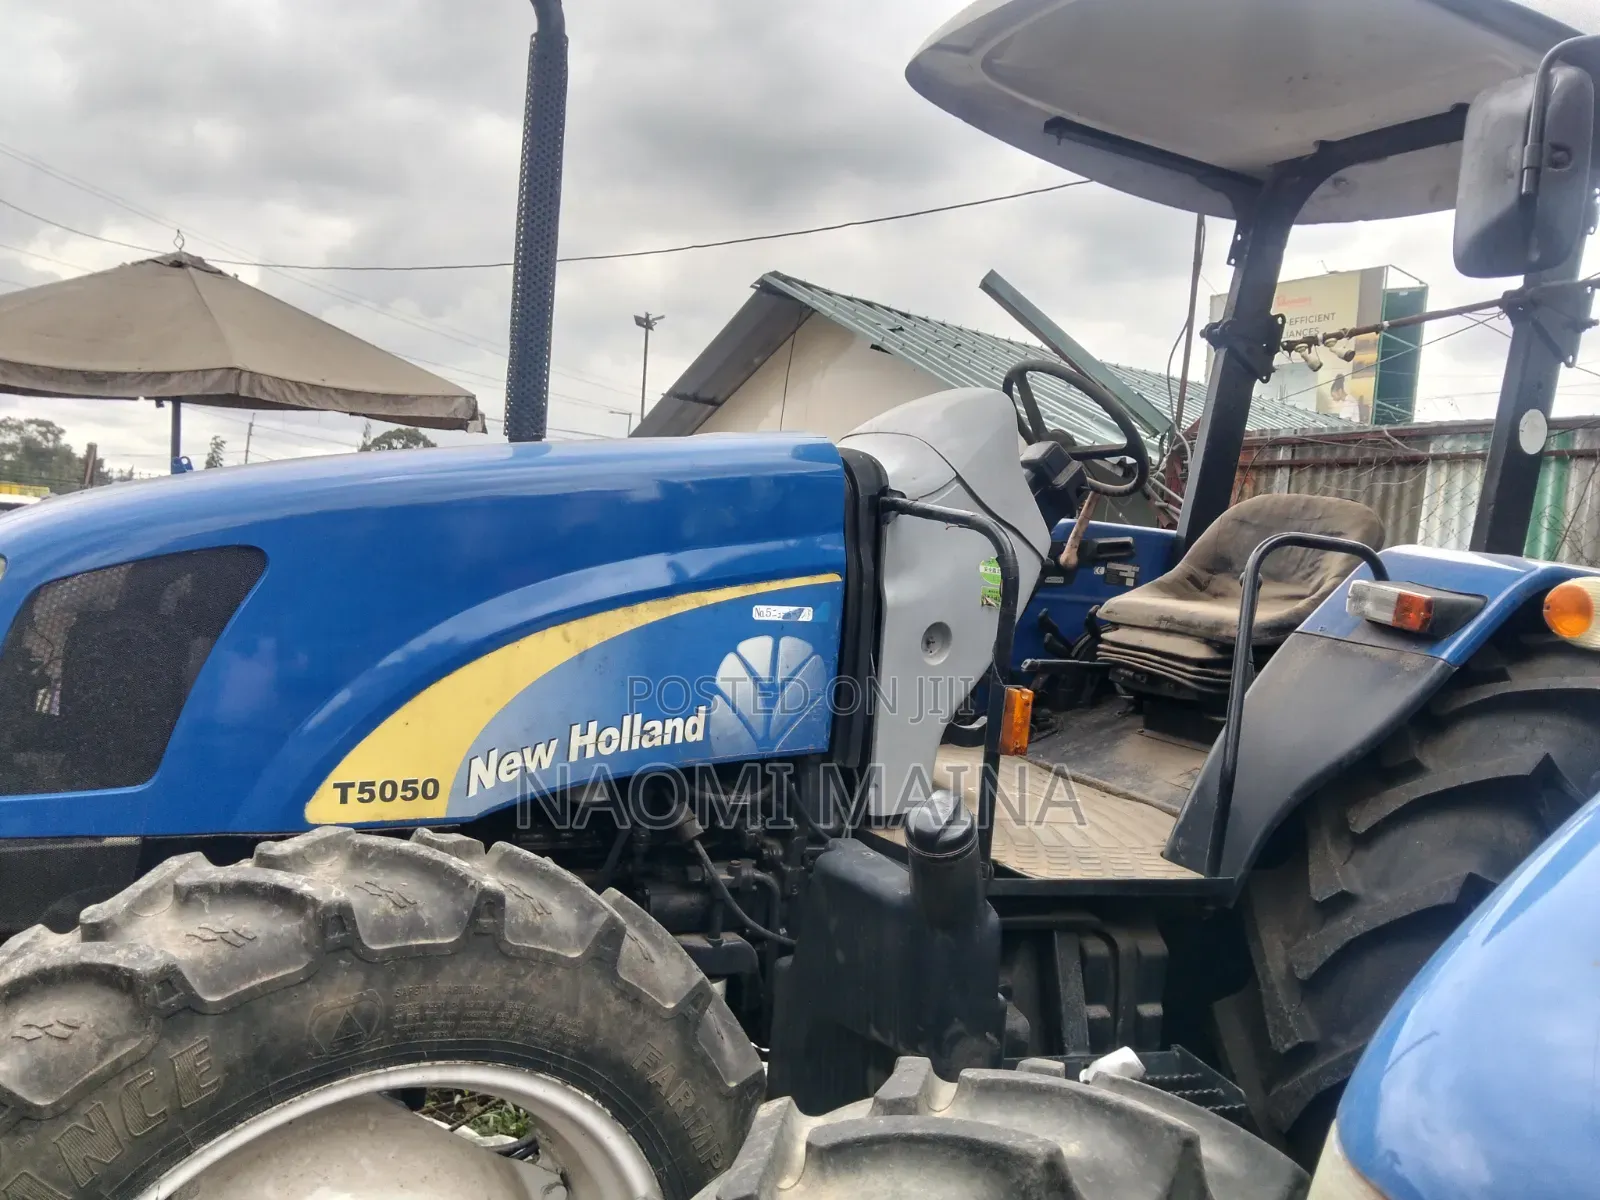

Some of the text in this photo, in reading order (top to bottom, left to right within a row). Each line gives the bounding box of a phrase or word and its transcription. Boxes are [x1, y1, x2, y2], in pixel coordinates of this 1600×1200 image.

[466, 704, 708, 798] New Holland
[333, 778, 440, 805] T5050
